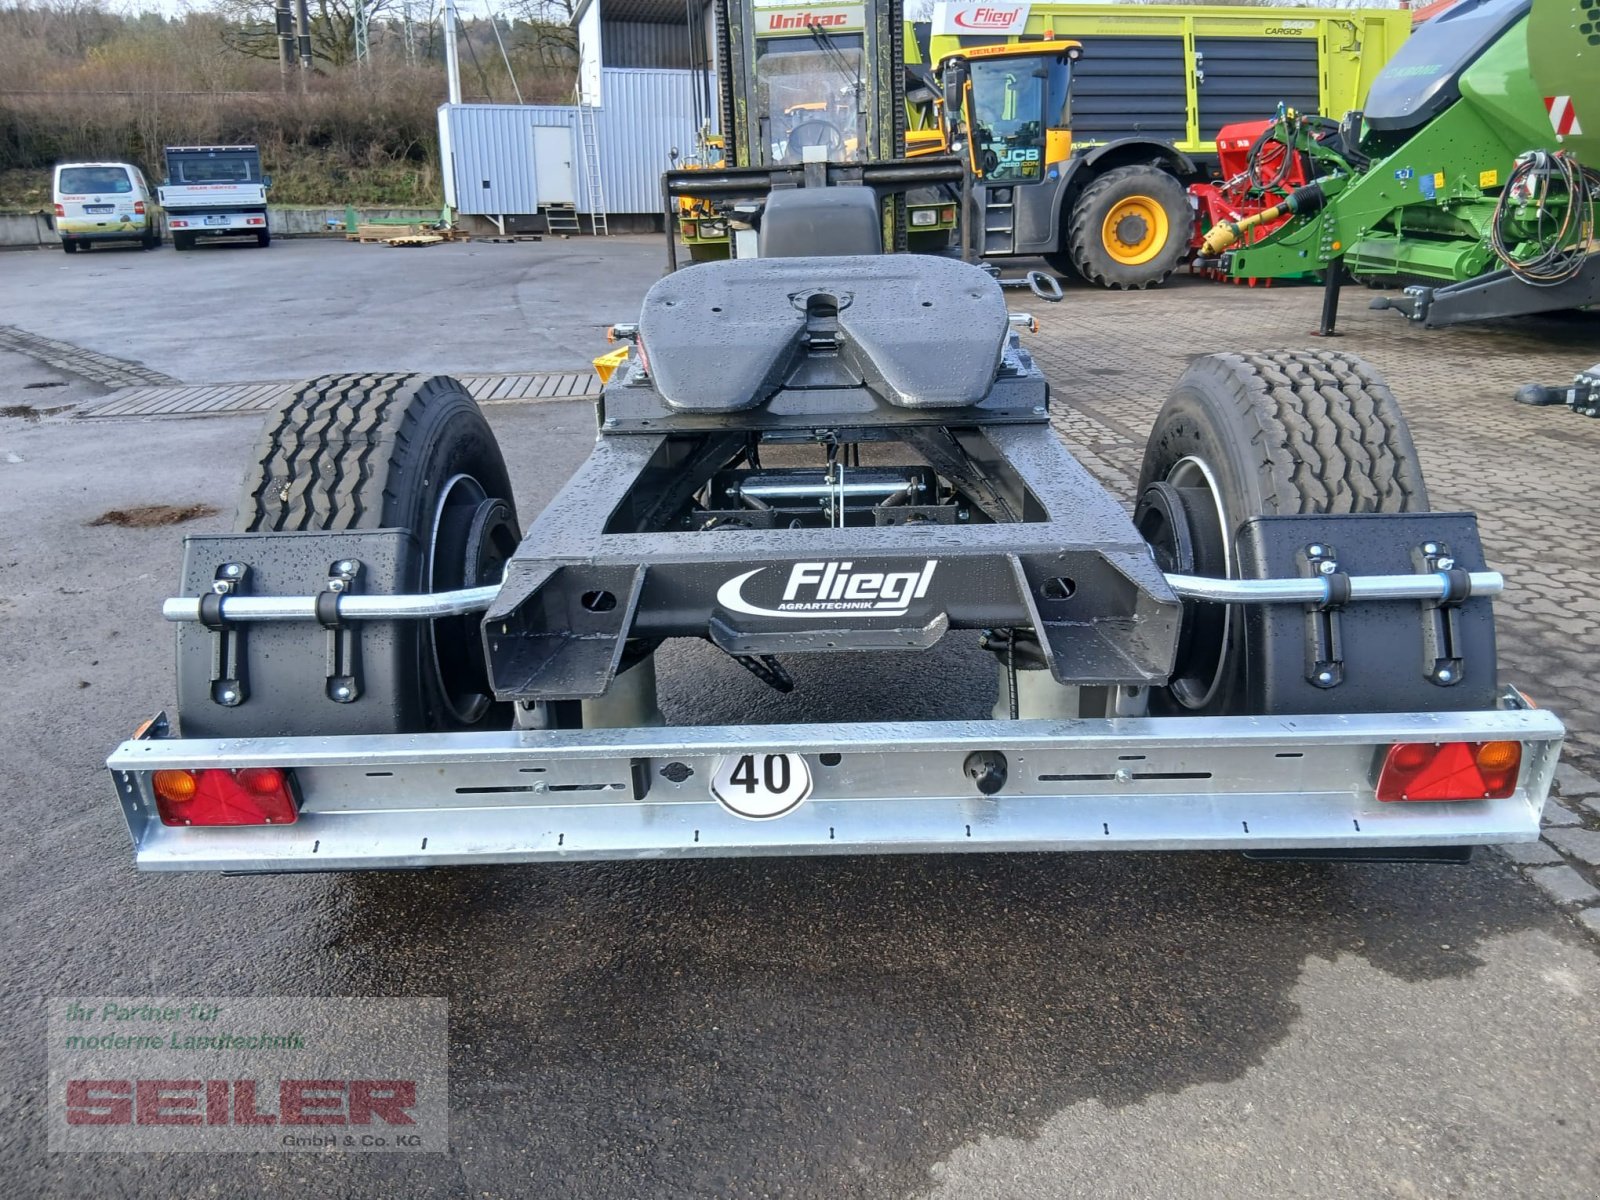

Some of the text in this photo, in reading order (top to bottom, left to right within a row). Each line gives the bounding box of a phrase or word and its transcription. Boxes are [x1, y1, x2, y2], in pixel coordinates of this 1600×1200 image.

[769, 12, 848, 30] Unitrac
[973, 7, 1019, 26] Fliegl
[1264, 27, 1303, 36] CARGOS
[1000, 149, 1039, 162] JCB
[782, 559, 938, 609] Fliegl
[777, 601, 874, 611] AGRARTECHNIK
[729, 753, 791, 794] 40
